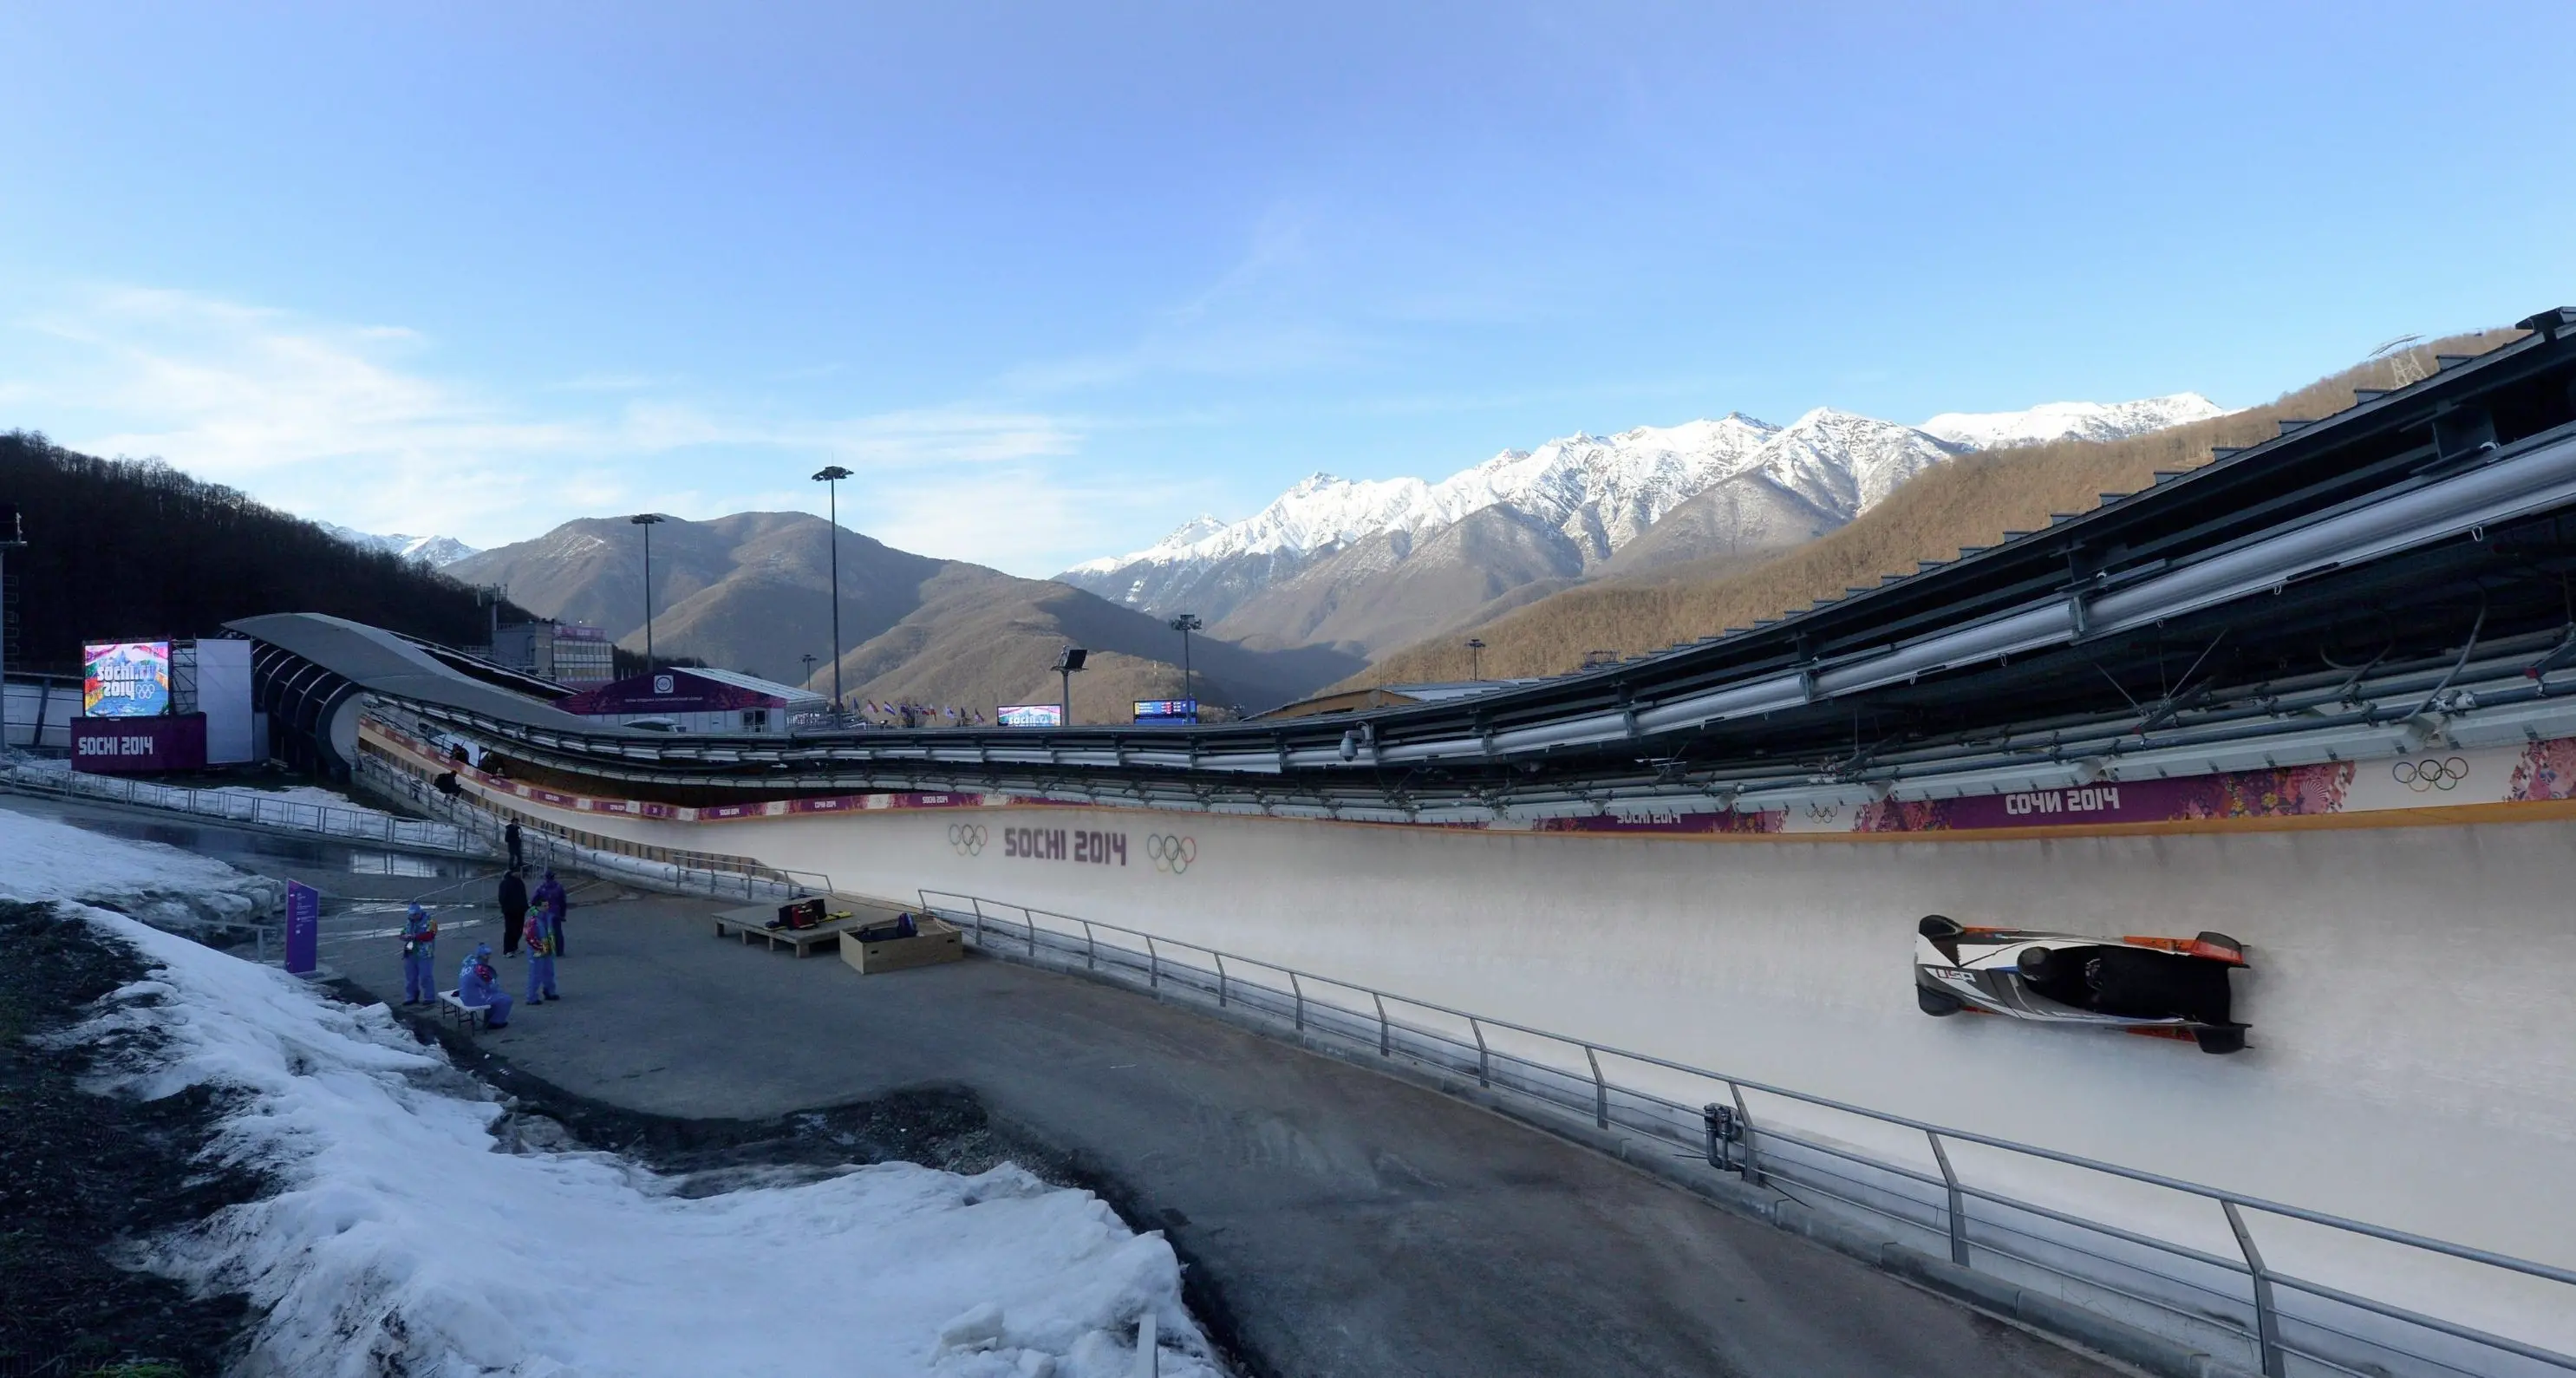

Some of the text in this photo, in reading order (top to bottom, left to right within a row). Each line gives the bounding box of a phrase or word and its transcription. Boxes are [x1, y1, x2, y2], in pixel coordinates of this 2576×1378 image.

[103, 681, 135, 700] 2014
[78, 736, 153, 755] SOCHI 2014
[2005, 787, 2120, 814] СОЧИ 2014
[1653, 813, 1681, 824] 2014
[1005, 827, 1126, 866] SOCHI 2014
[1936, 968, 1976, 982] USA
